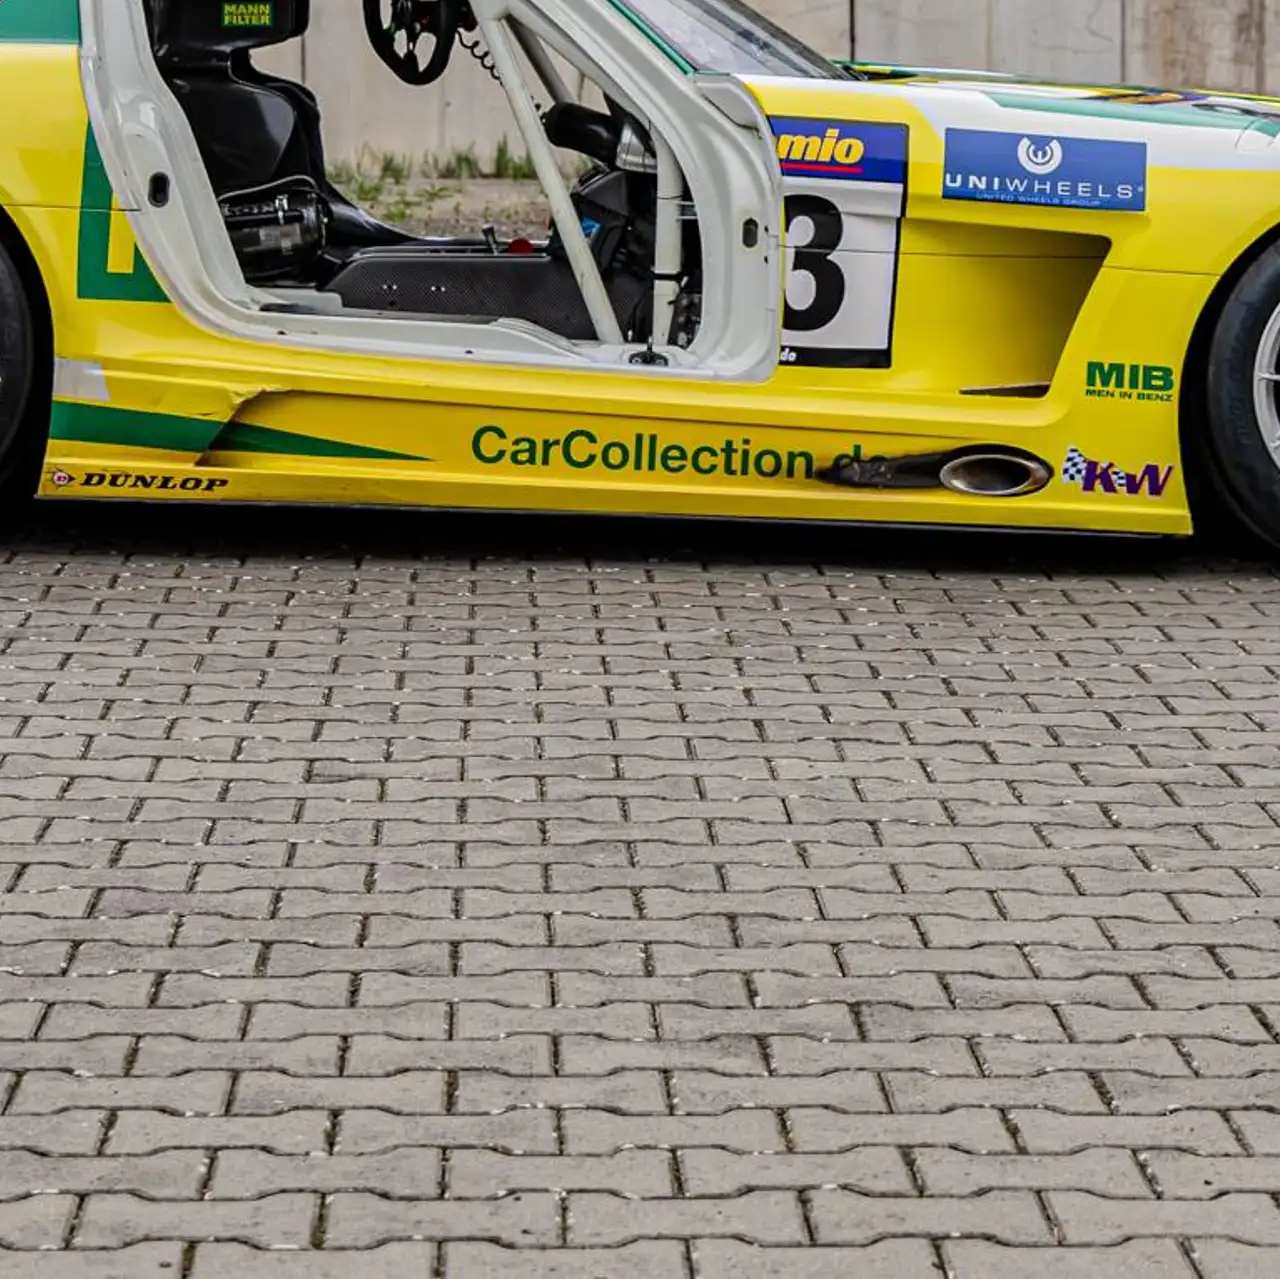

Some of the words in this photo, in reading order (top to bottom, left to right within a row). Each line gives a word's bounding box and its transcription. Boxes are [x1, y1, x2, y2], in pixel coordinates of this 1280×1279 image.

[223, 3, 269, 15] MANN
[782, 194, 845, 331] 3
[1086, 361, 1174, 390] MIB
[1085, 389, 1115, 397] MEN
[1119, 391, 1132, 400] IN
[1137, 392, 1173, 402] BENZ
[80, 472, 229, 491] DUNLOP
